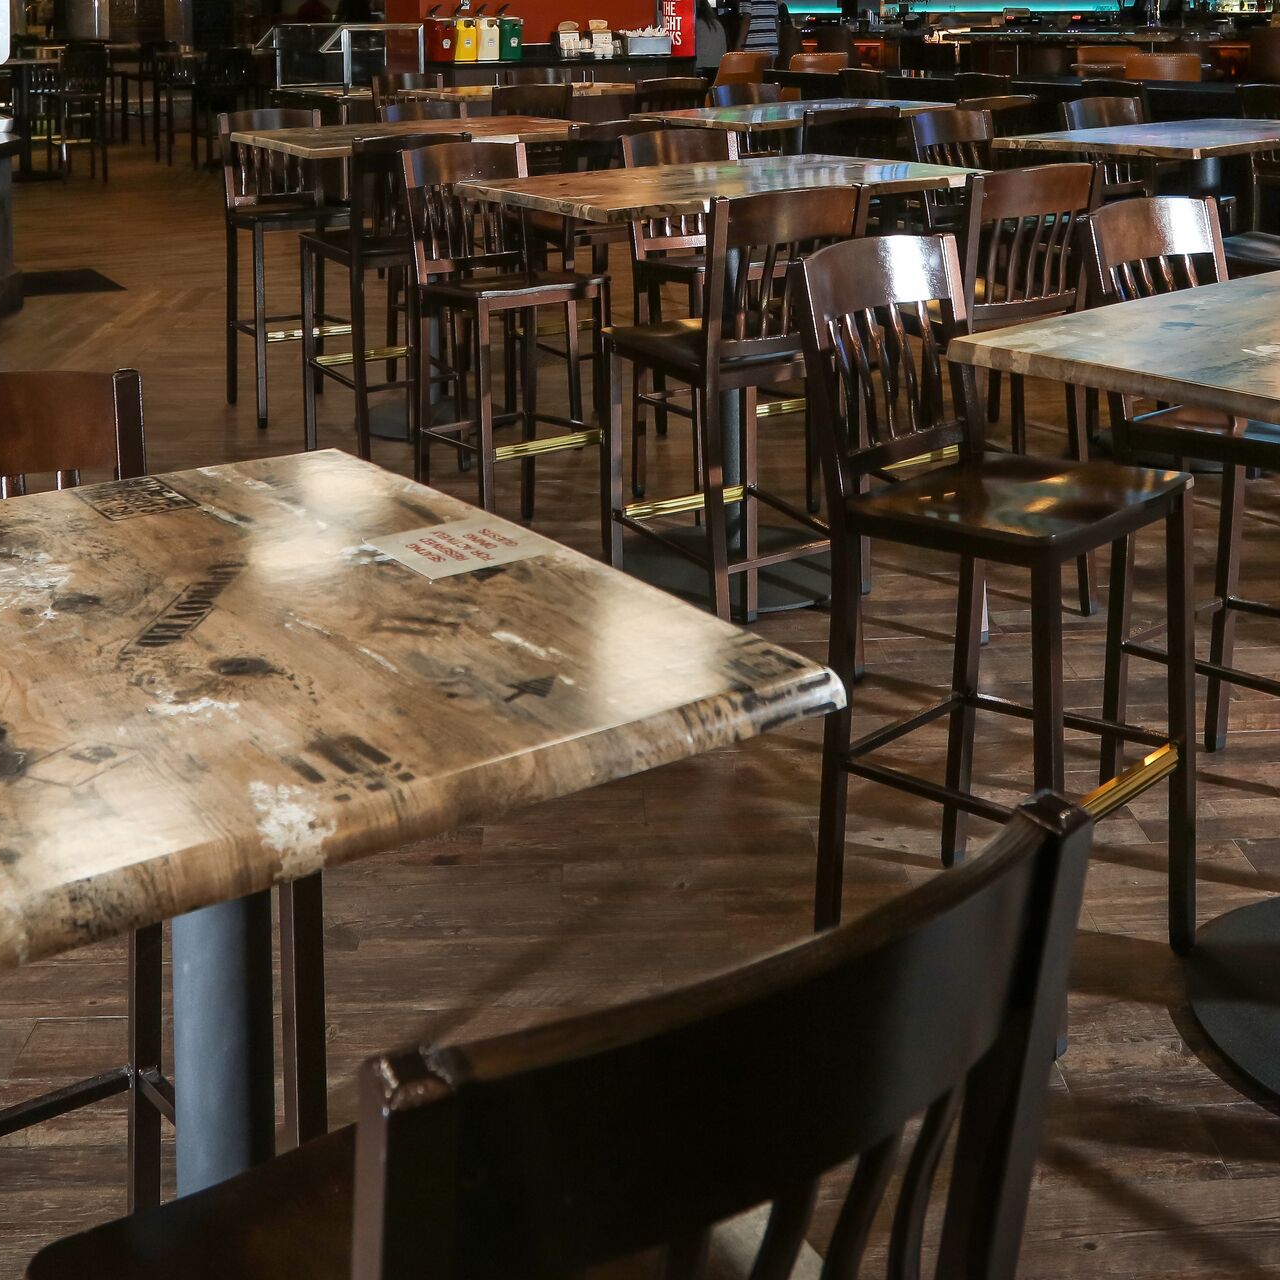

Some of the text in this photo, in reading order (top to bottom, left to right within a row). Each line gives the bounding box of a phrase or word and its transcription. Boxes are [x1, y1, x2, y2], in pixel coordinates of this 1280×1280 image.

[431, 530, 496, 561] FOR ACTIVELY
[463, 533, 498, 550] DINING
[478, 528, 518, 548] GUESTS
[405, 543, 446, 563] SEATING
[419, 537, 470, 561] RESERVED
